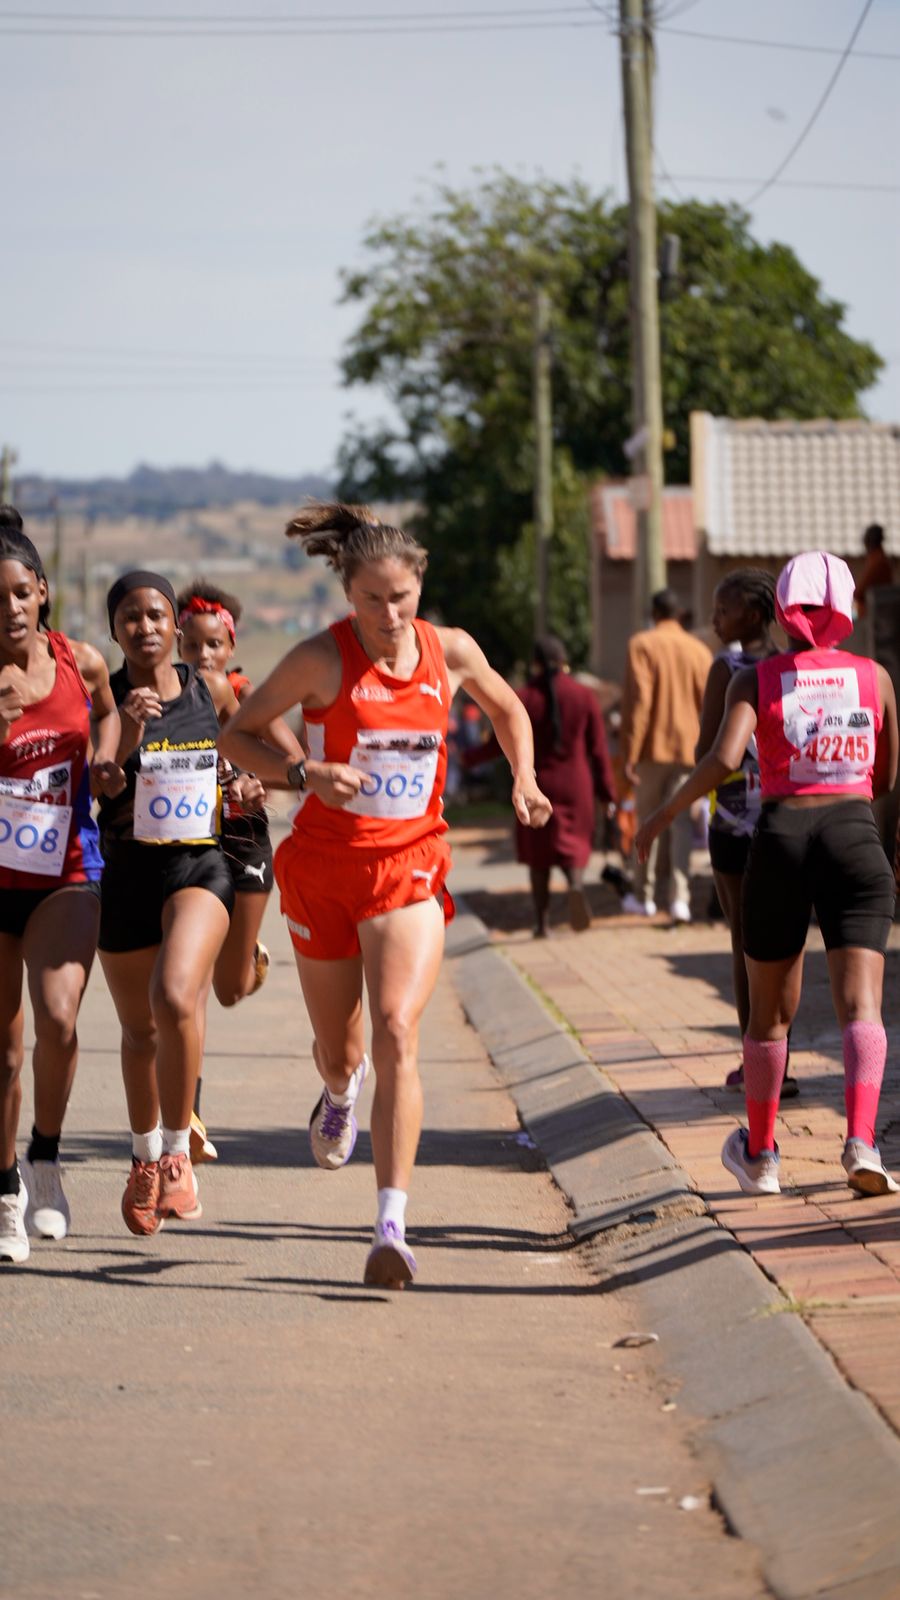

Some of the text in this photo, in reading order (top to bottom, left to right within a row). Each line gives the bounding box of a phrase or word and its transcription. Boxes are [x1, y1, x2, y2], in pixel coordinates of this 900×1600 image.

[794, 676, 844, 688] miway
[360, 772, 425, 798] 005
[149, 794, 208, 819] 066
